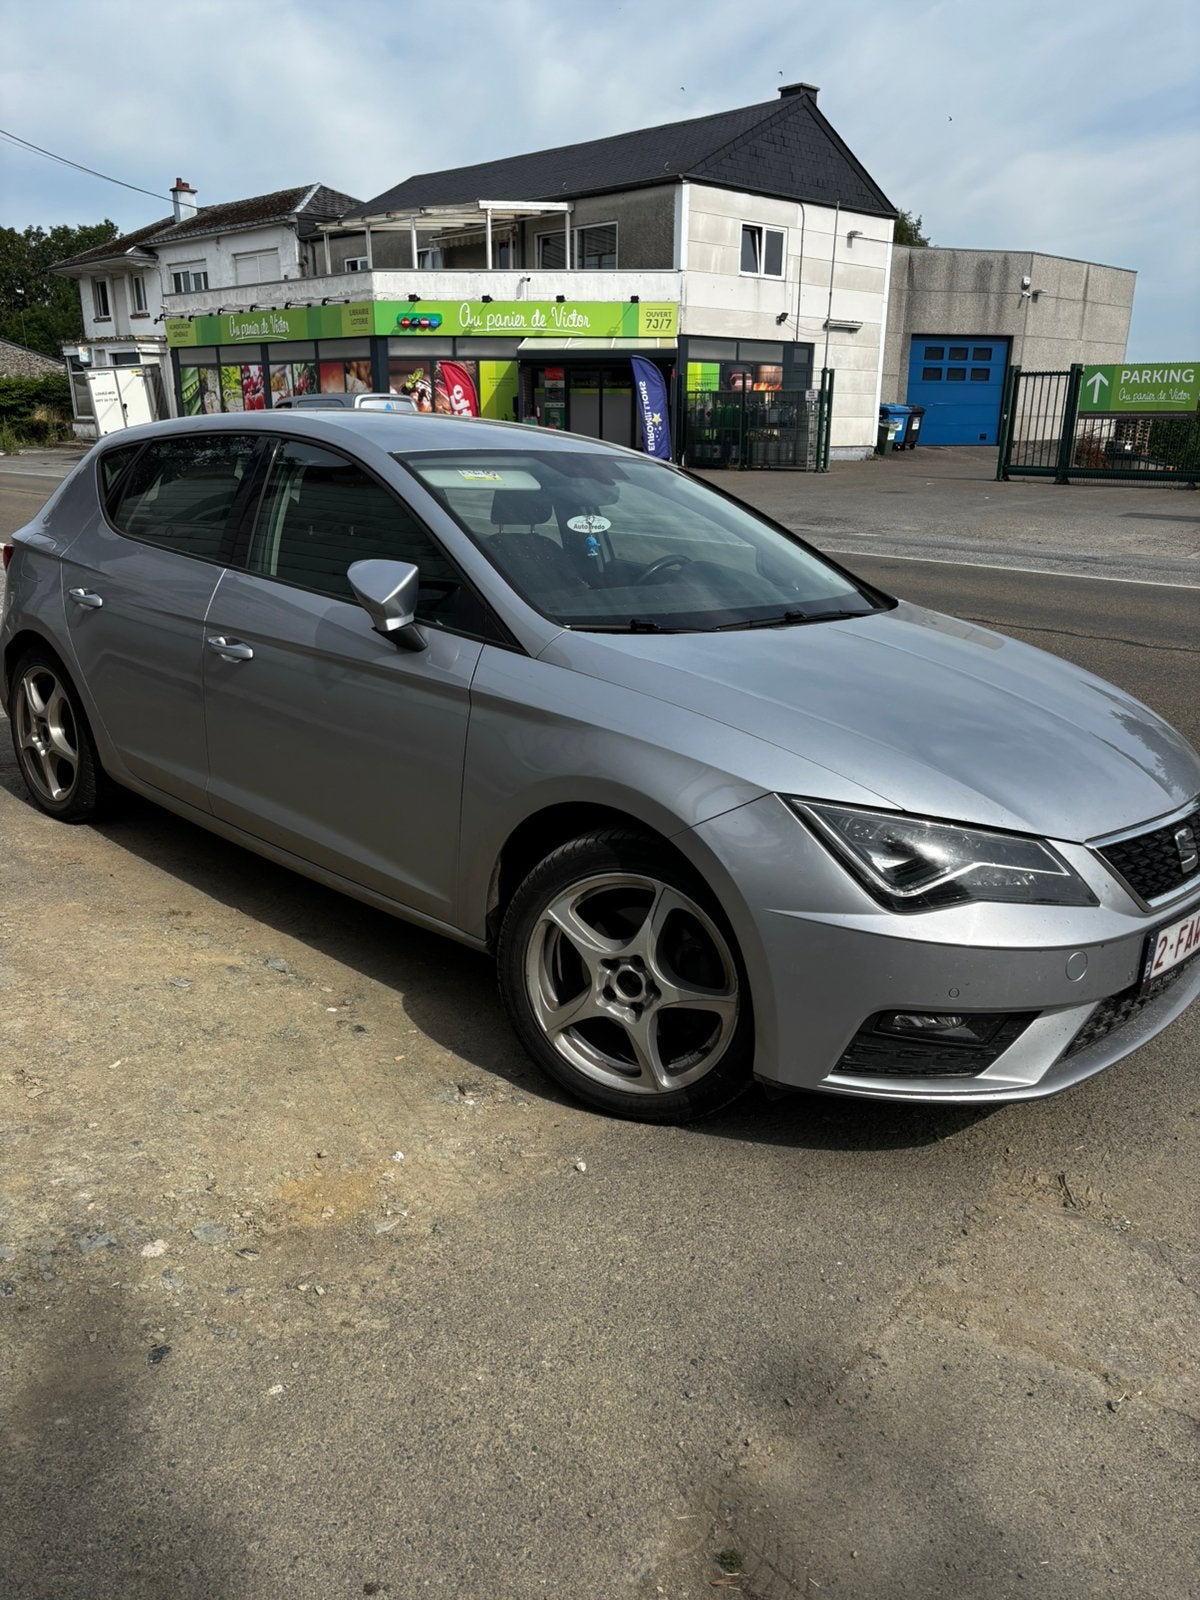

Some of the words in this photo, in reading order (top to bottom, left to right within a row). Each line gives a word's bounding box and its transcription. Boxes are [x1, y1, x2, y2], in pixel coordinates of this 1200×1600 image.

[459, 302, 482, 327] Au
[486, 312, 527, 332] panier
[530, 309, 547, 327] de
[551, 305, 590, 328] Victor
[645, 318, 672, 329] 7J/7
[229, 315, 240, 337] Au
[241, 321, 260, 339] panier
[261, 317, 269, 334] de
[270, 313, 289, 333] Victor
[1120, 369, 1195, 384] PARKING
[1118, 387, 1131, 401] Au
[1132, 391, 1155, 402] panier
[1157, 390, 1166, 400] de
[1168, 387, 1191, 401] Victor
